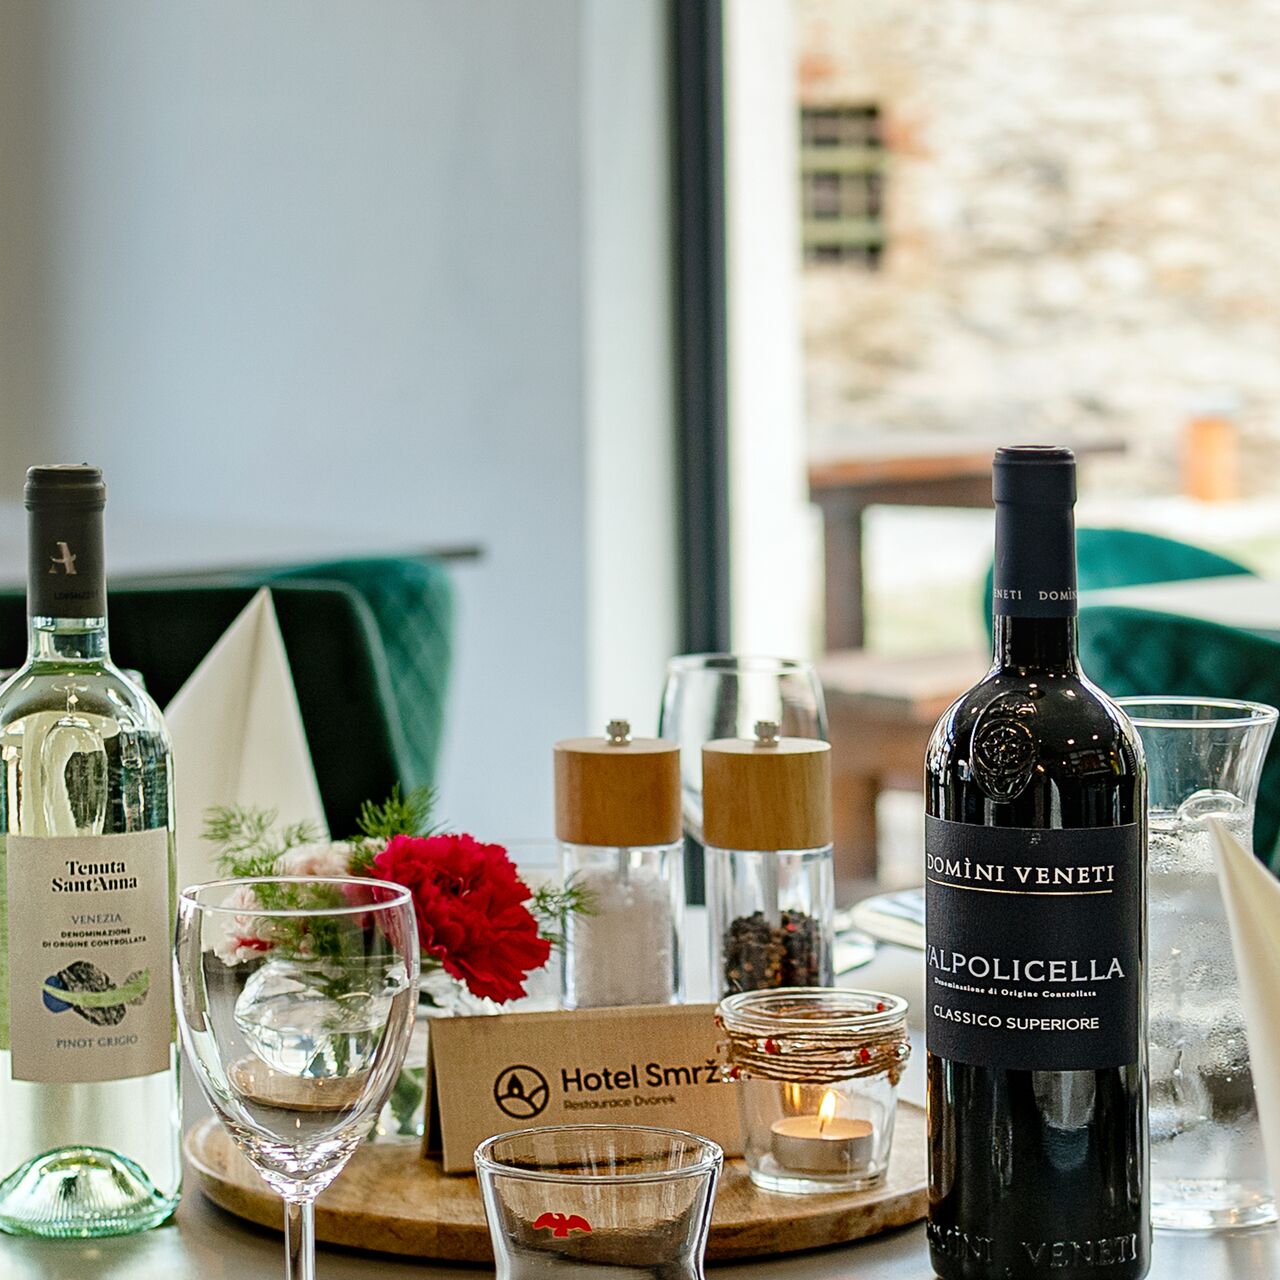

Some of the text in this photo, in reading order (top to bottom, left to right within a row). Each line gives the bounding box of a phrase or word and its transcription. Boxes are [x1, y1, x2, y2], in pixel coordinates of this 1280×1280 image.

[993, 587, 1078, 600] ENETI DOMÌN
[65, 861, 126, 876] Tenuta
[927, 853, 1115, 885] DOMÌNI VENETI
[52, 876, 138, 892] Sant'Anna
[71, 913, 122, 925] VENEZIA
[61, 928, 131, 939] DENOMINAZIONE
[42, 936, 147, 949] DI ORIGINE CONTROLLATA
[988, 986, 997, 995] di
[1001, 987, 1038, 998] Origine
[1042, 989, 1097, 998] Controllata
[933, 1004, 1100, 1031] CLASSICO SUPERIORE
[56, 1034, 138, 1049] PINOT GRIGIO
[561, 1058, 721, 1093] Hotel Smrž
[563, 1097, 632, 1110] Restaurace
[1020, 1232, 1138, 1268] VENETI
